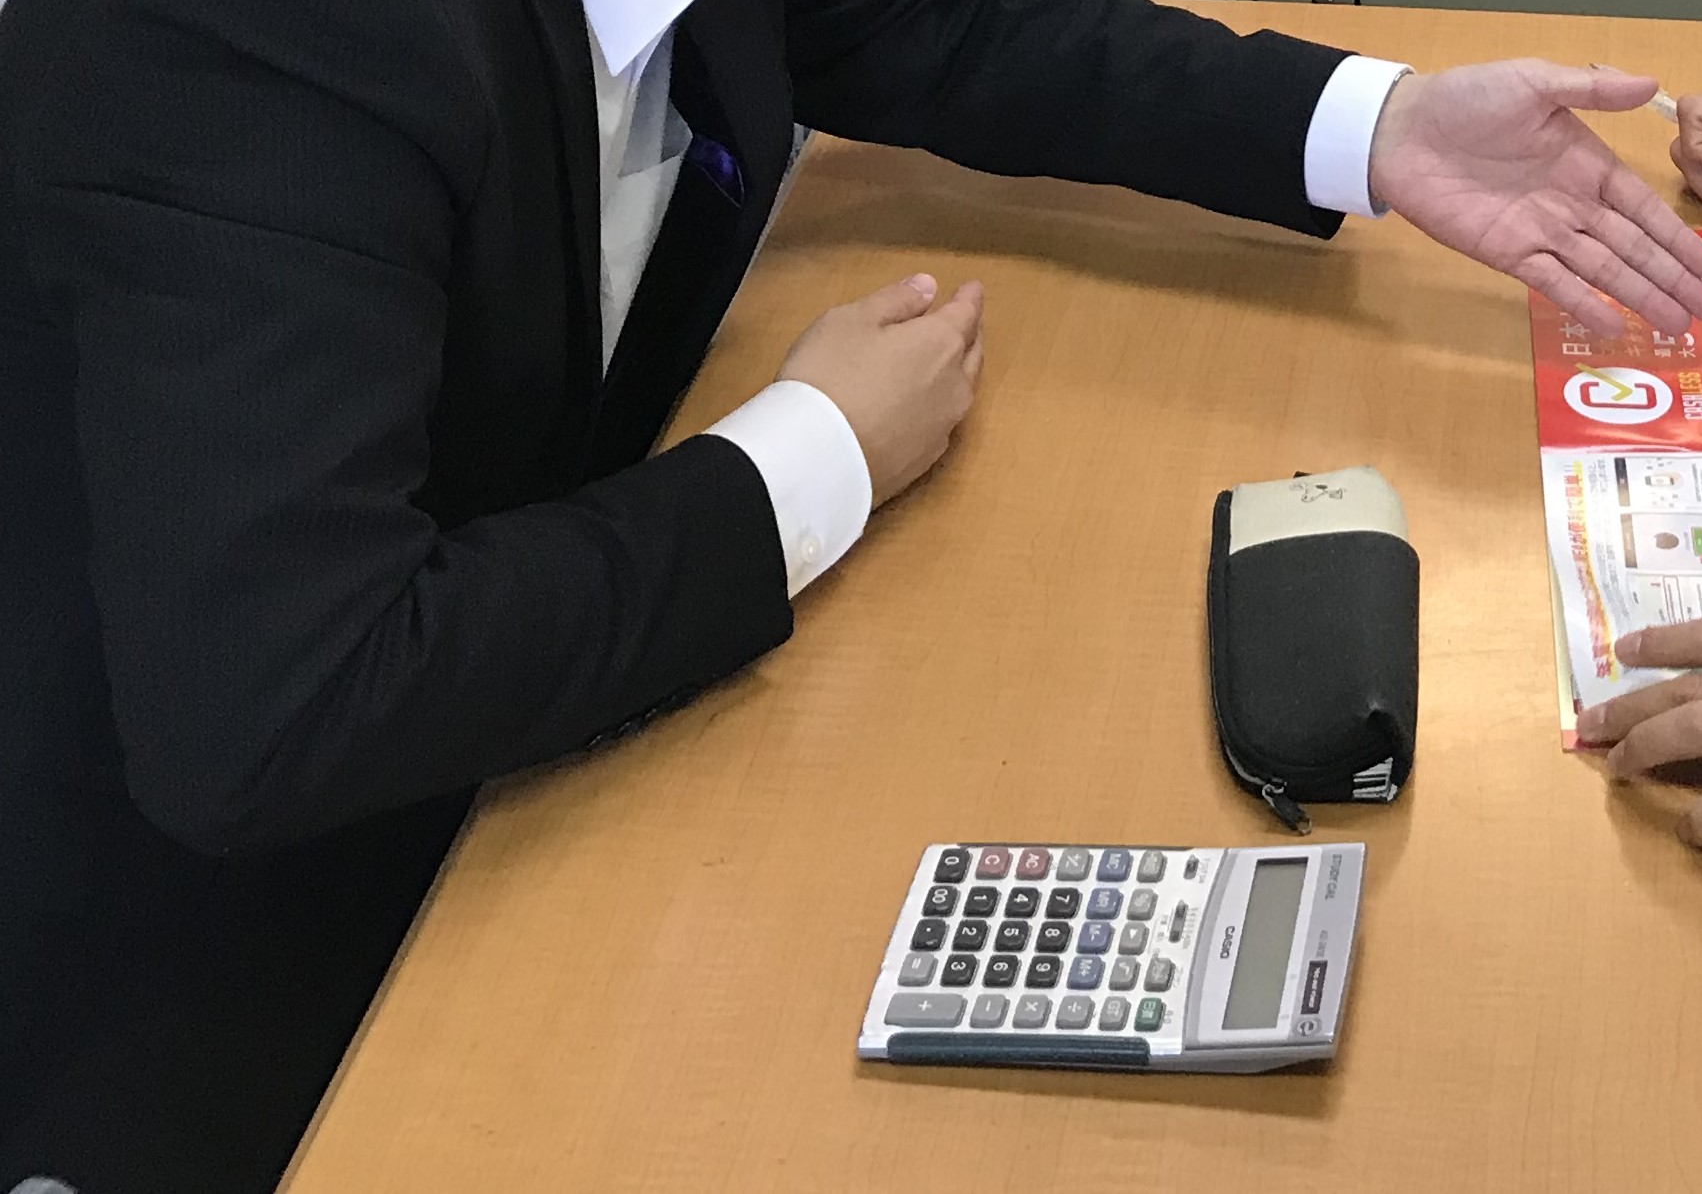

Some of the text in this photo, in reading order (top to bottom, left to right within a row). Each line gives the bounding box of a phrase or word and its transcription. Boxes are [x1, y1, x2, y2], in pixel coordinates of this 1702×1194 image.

[945, 856, 959, 866] 0
[985, 854, 1000, 865] C
[1025, 853, 1040, 869] AC
[932, 888, 949, 904] 00
[961, 926, 977, 936] 2
[1004, 927, 1020, 936] 5
[1045, 928, 1061, 938] 8
[1220, 925, 1236, 959] CASIO
[950, 961, 966, 971] 3
[993, 961, 1009, 971] 6
[1035, 962, 1051, 972] 9
